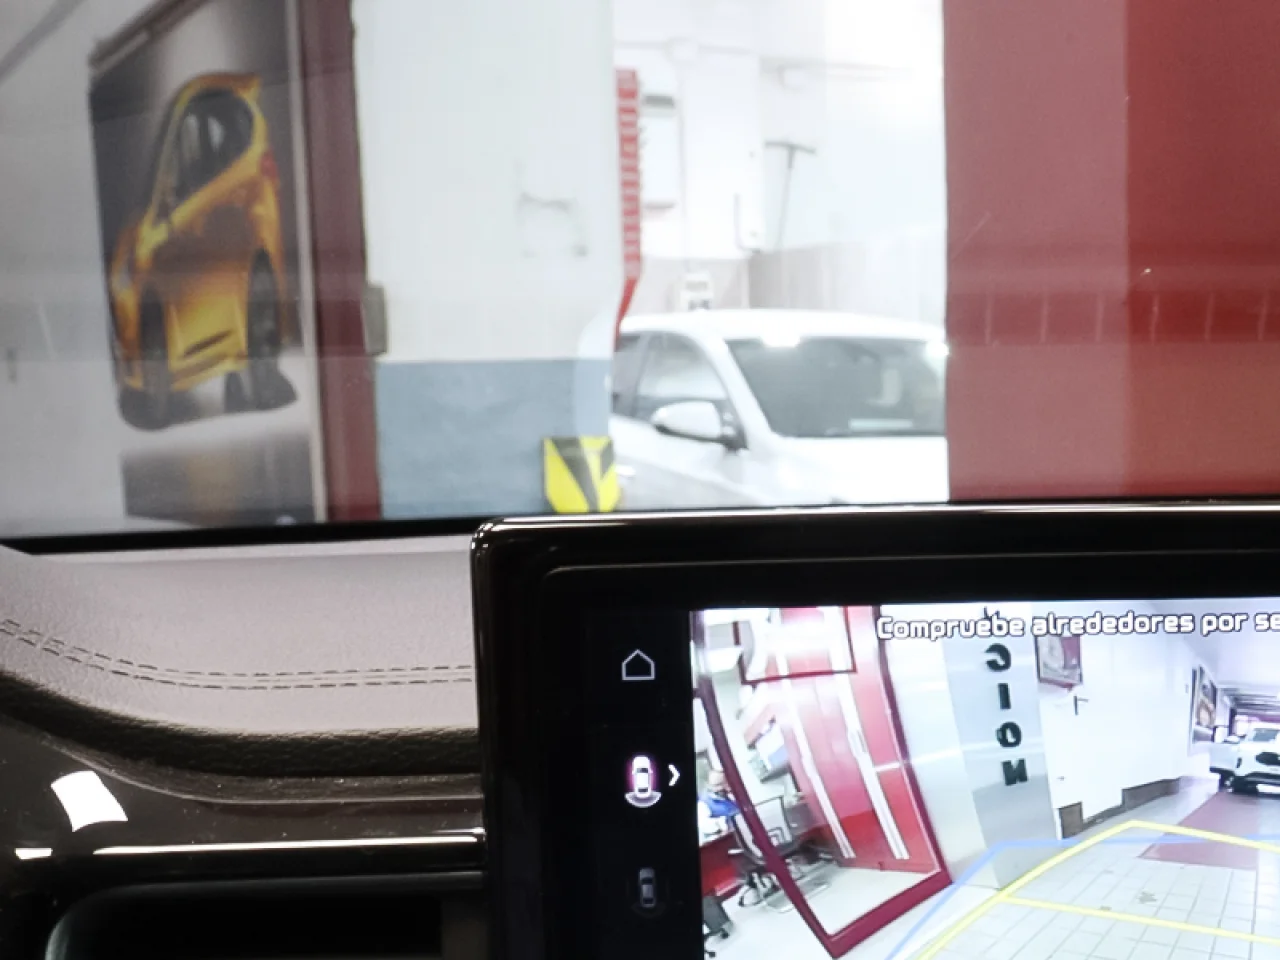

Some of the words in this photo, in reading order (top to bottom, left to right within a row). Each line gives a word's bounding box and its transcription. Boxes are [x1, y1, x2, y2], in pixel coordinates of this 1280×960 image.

[876, 613, 1025, 641] Compruebe
[1031, 610, 1196, 636] alrededores
[1202, 612, 1249, 637] por
